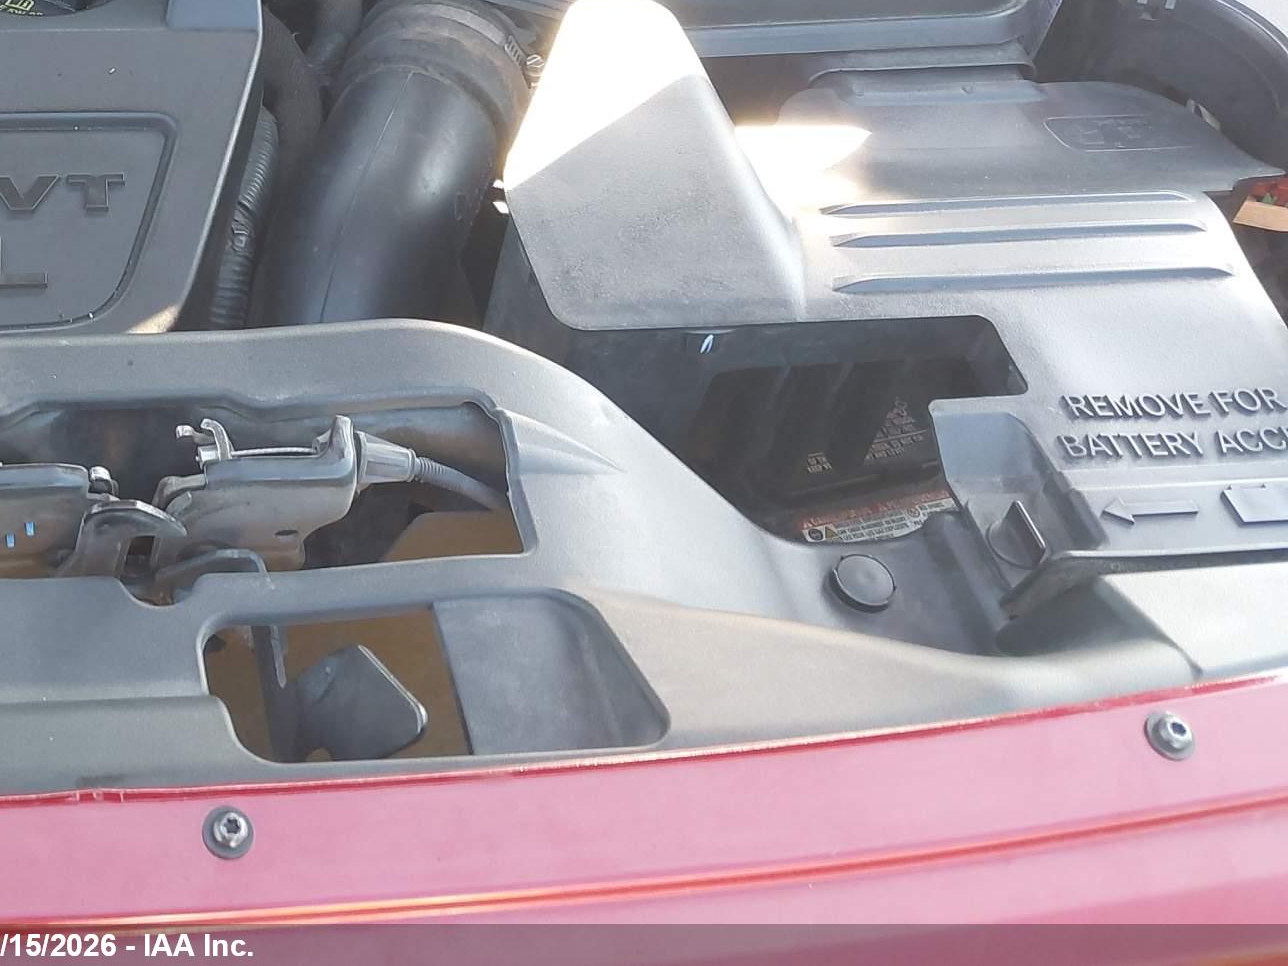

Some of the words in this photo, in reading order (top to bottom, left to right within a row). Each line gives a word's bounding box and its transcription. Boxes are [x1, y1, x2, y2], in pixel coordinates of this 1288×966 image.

[1061, 392, 1212, 420] REMOVE
[1209, 387, 1288, 414] FOR
[1057, 431, 1204, 458] BATTERY
[1214, 425, 1288, 455] ACC
